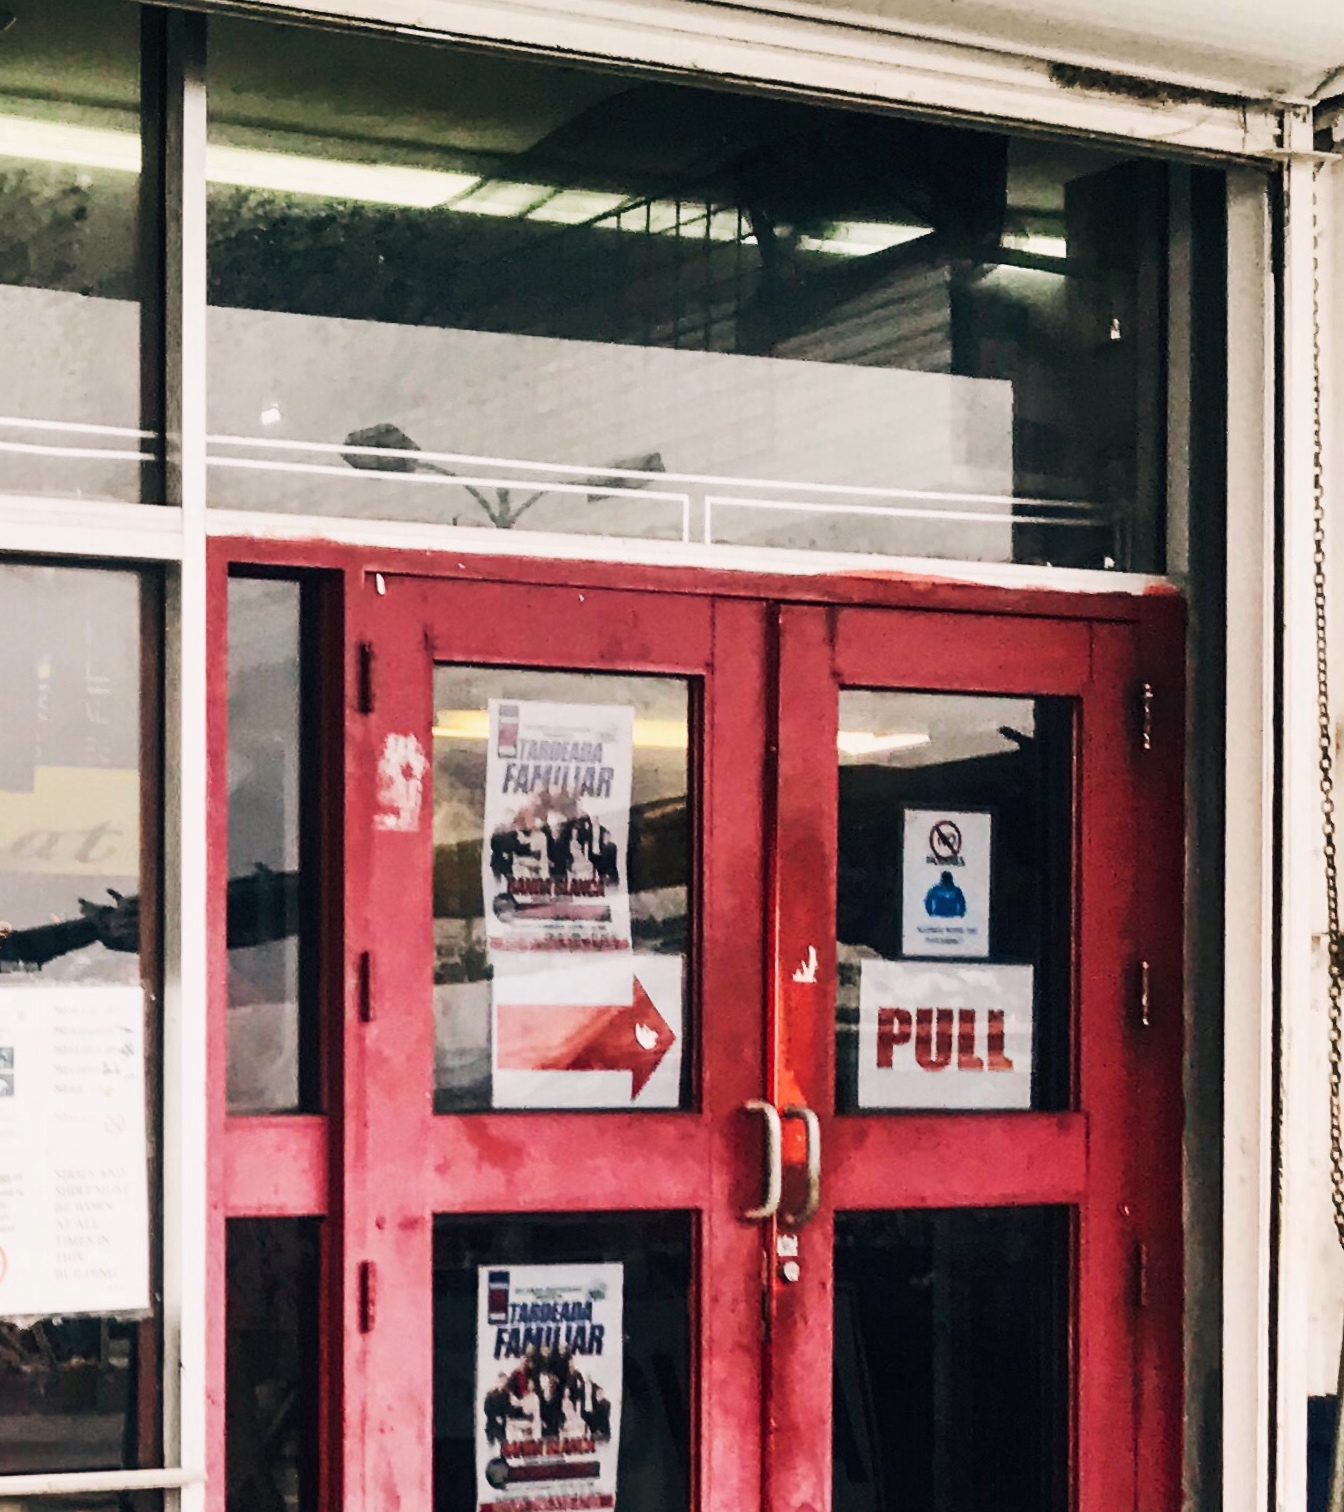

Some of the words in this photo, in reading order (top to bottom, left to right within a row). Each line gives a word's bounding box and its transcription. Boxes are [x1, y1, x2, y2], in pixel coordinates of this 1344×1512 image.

[502, 763, 614, 798] FAMILIAR
[876, 1007, 1013, 1072] PULL
[494, 1324, 605, 1360] FAMILIAR
